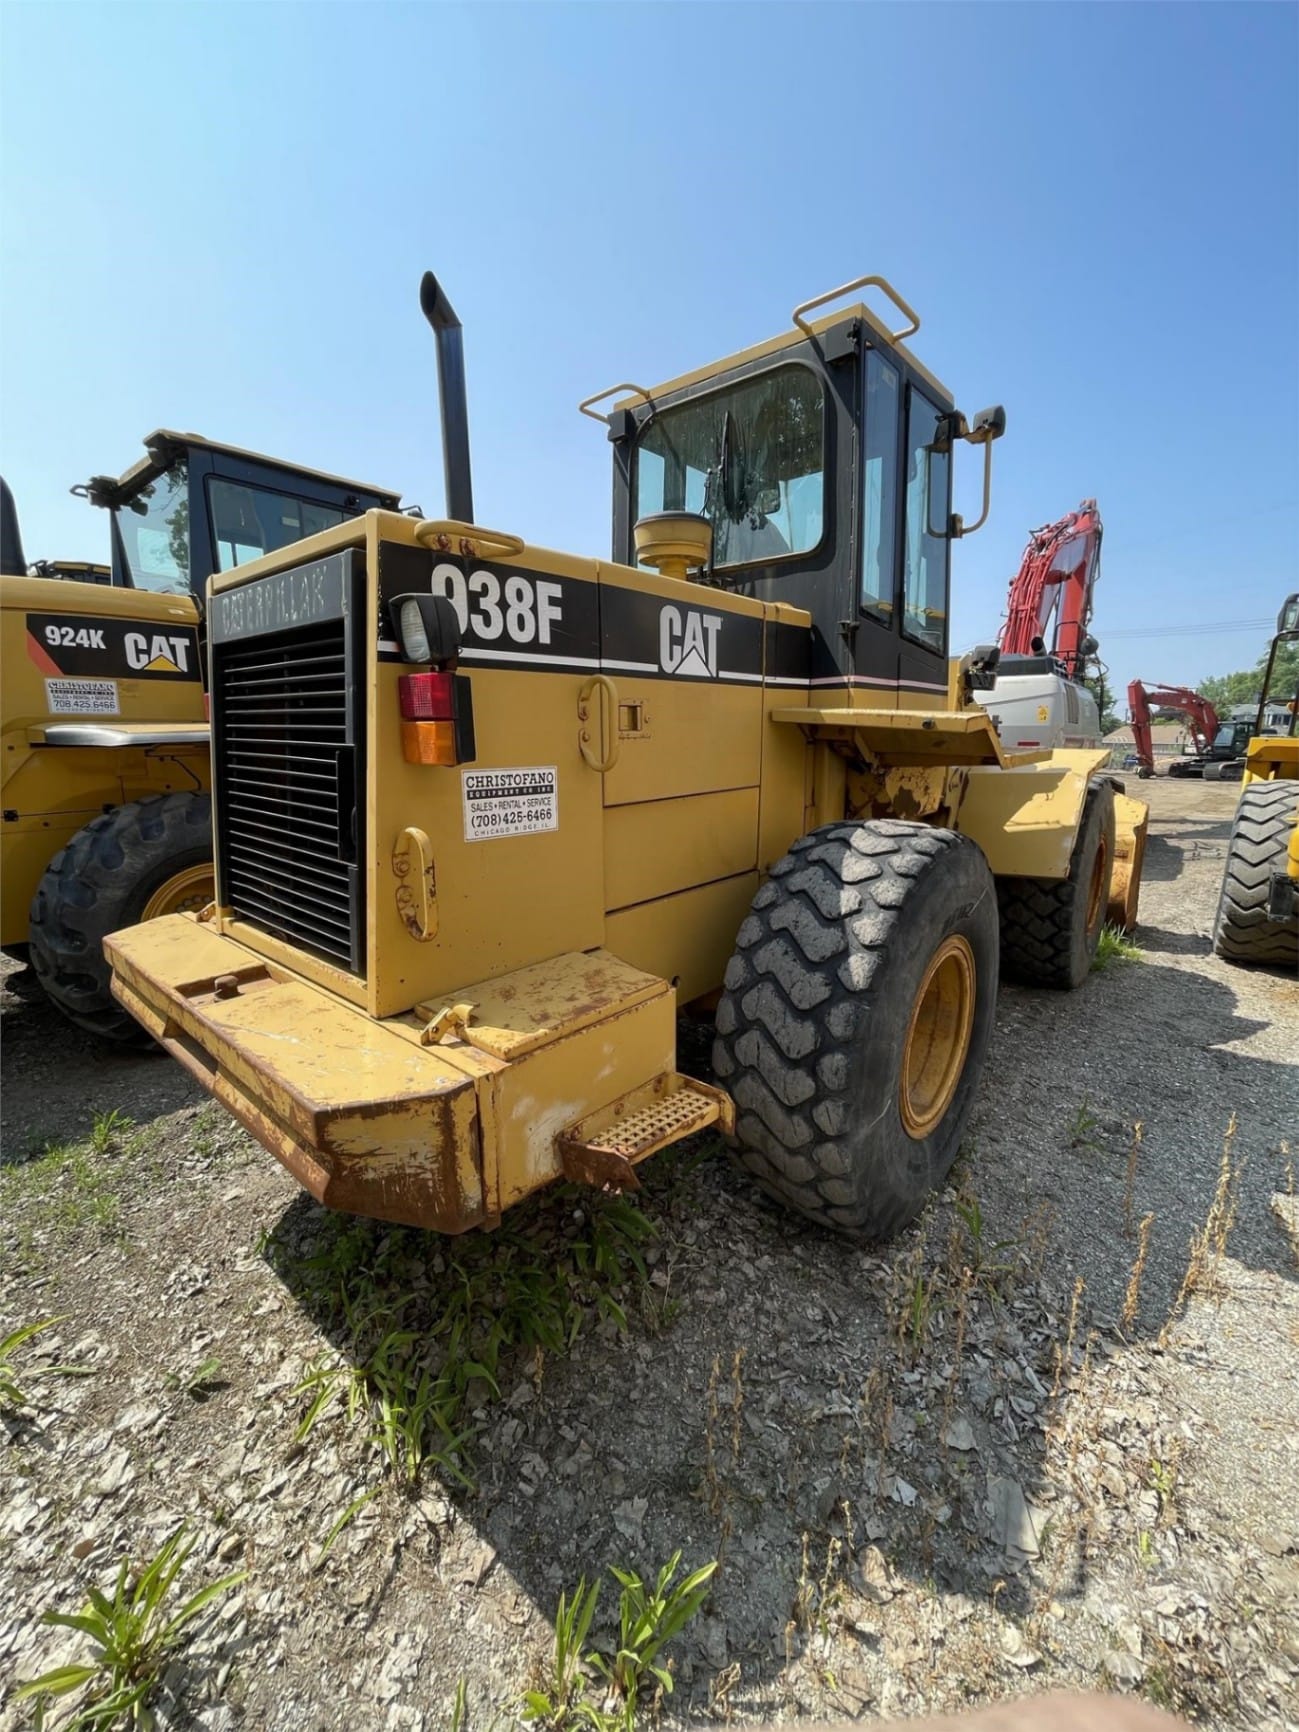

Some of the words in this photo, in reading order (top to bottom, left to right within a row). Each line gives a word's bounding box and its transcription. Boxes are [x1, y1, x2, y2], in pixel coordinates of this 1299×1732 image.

[431, 563, 563, 645] 938F
[45, 625, 107, 649] 924K
[659, 605, 722, 678] CAT
[124, 632, 190, 673] CAT
[466, 772, 554, 789] CHRISTOFANO
[469, 788, 519, 798] EQUIPMENT
[471, 801, 493, 813] SALES
[498, 800, 522, 810] RENTAL
[526, 797, 552, 808] SERVICE
